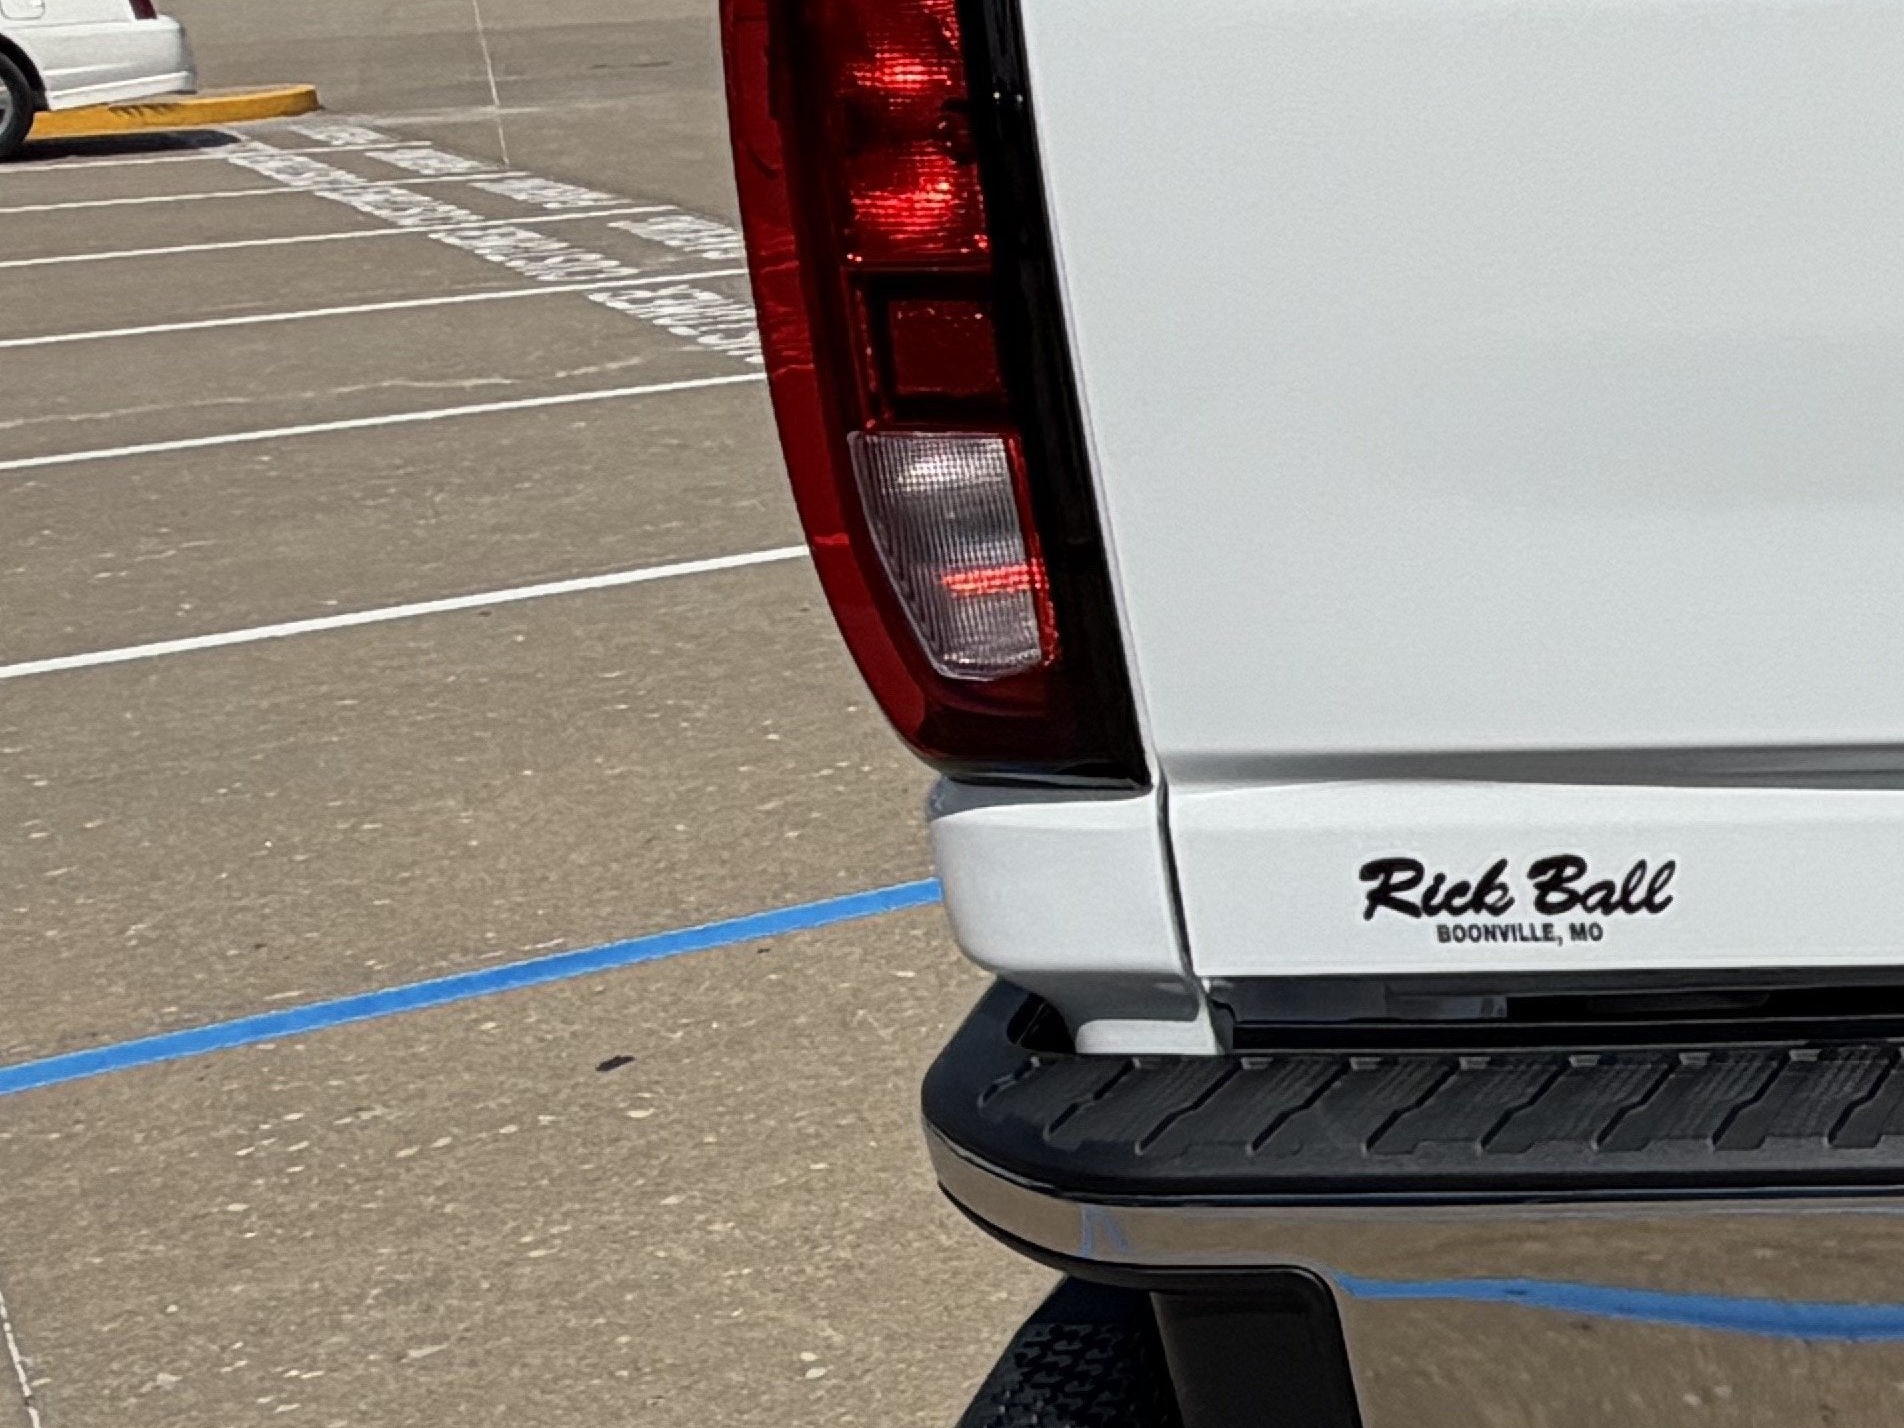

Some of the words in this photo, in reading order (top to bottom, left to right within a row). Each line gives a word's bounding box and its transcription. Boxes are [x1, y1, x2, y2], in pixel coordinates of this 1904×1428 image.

[1358, 856, 1516, 922] Rick
[1526, 853, 1677, 917] Ball
[1436, 922, 1564, 946] BOONVILLE,
[1569, 922, 1604, 943] MO
